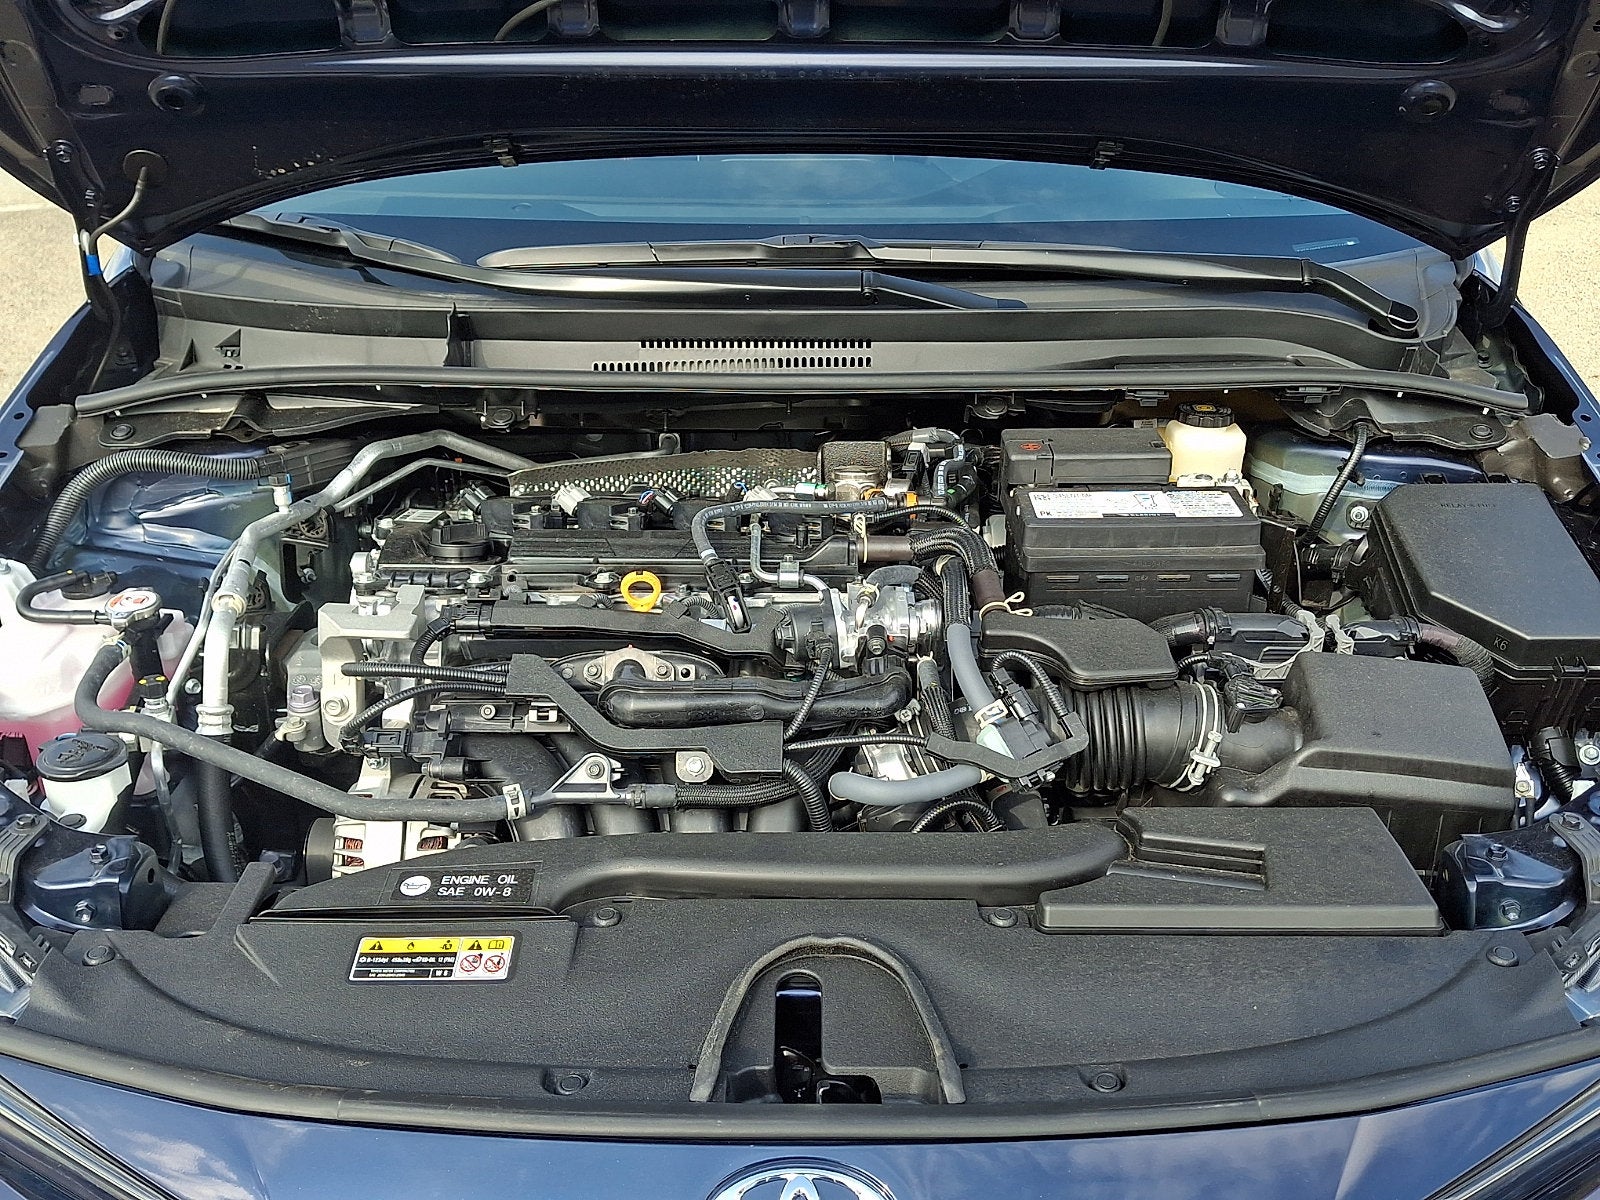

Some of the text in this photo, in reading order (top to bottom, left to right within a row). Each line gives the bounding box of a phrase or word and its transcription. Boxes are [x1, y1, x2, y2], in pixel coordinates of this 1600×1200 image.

[1493, 637, 1508, 650] K6
[441, 874, 518, 885] ENGINE OIL
[437, 887, 512, 897] SAE 0W-8
